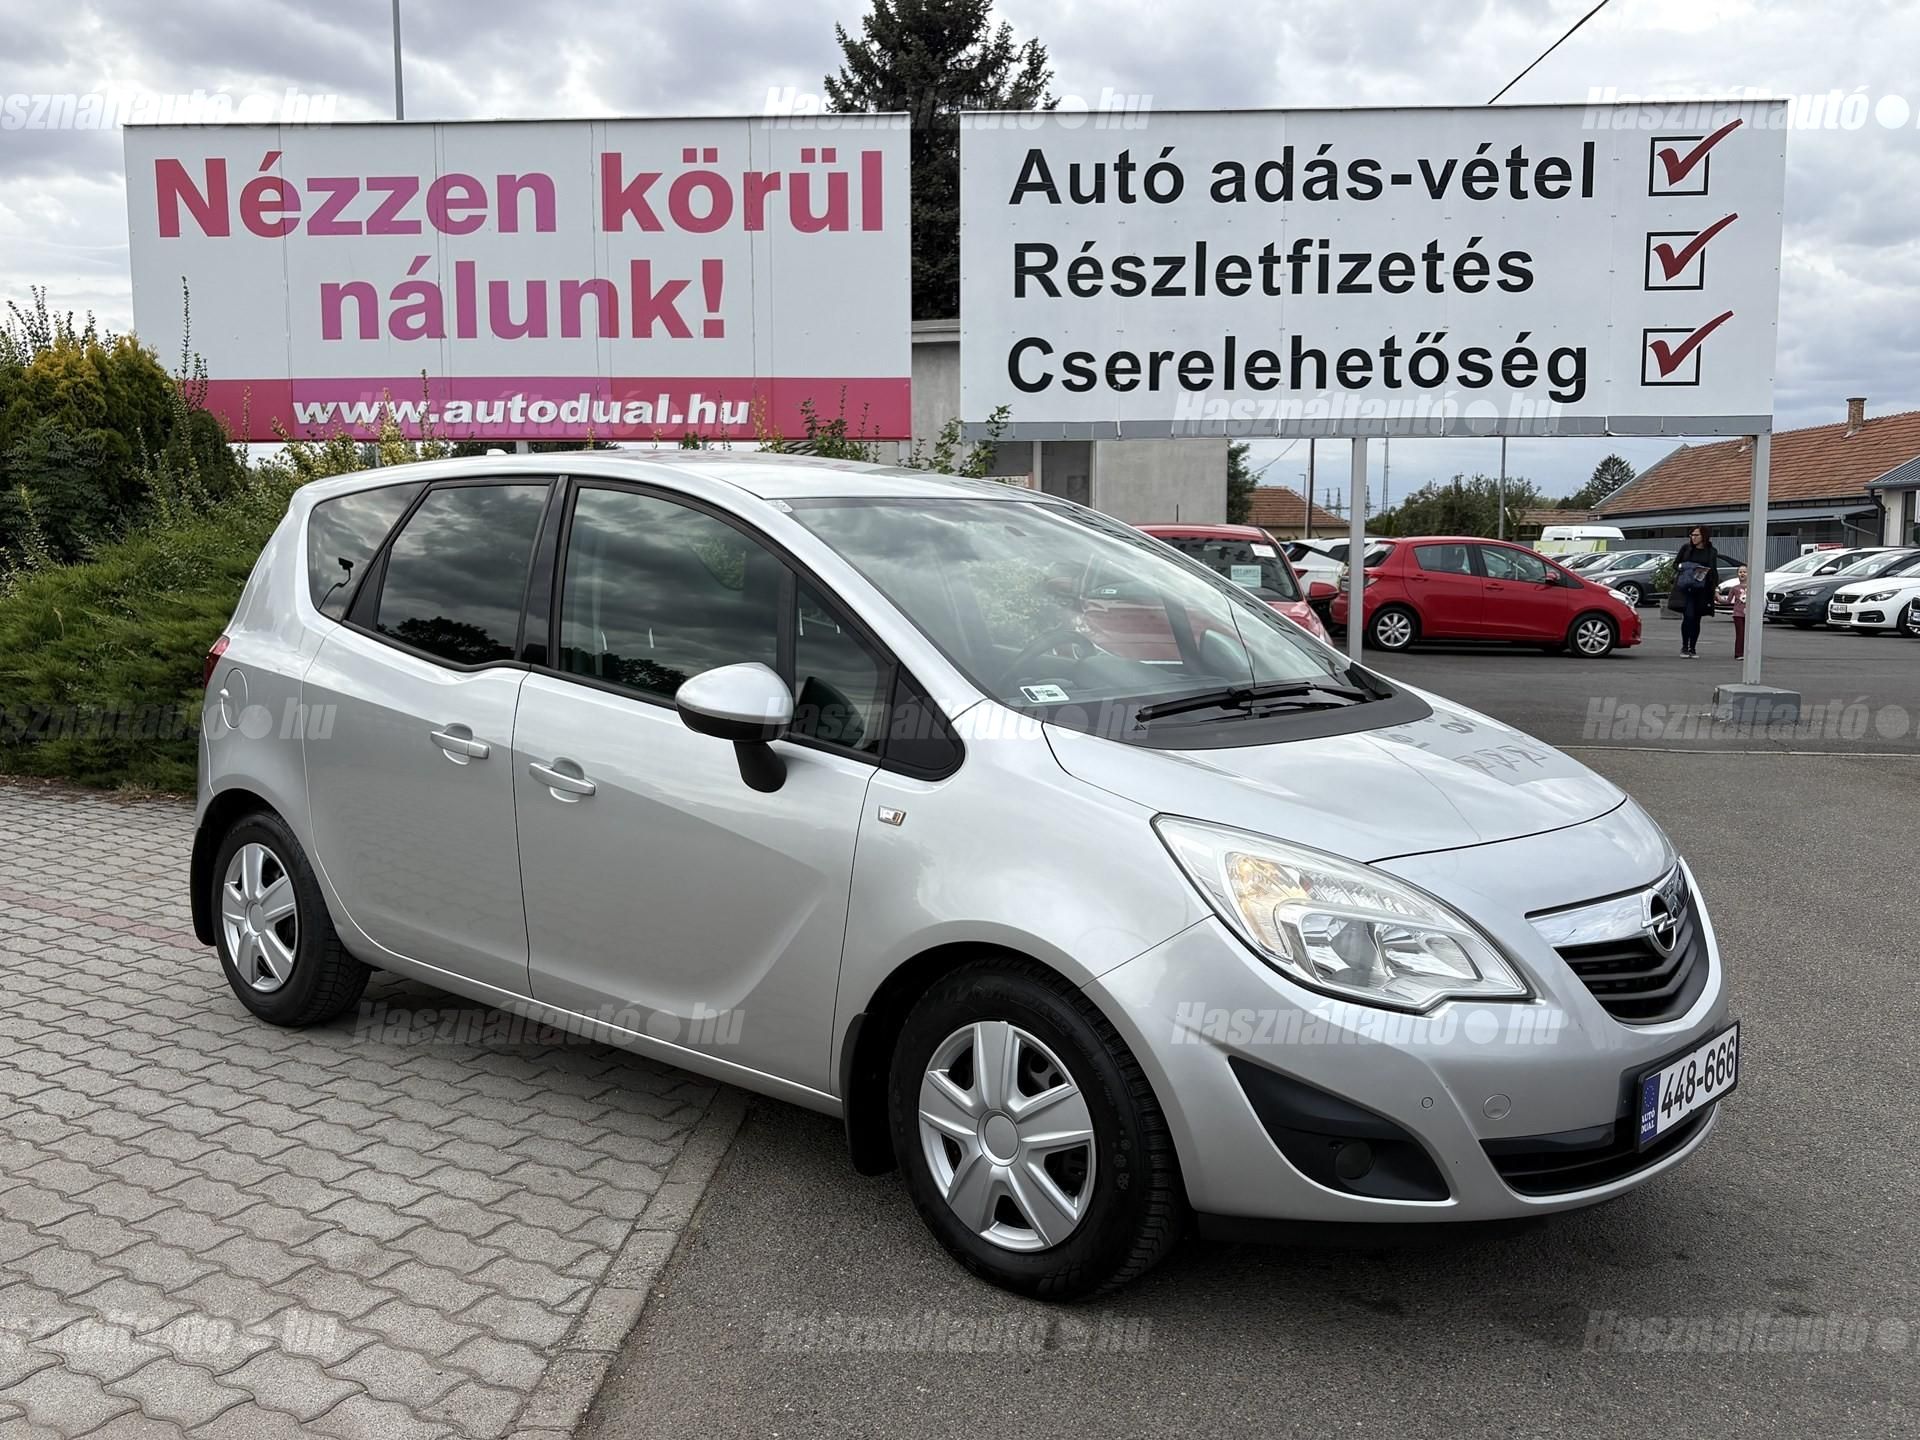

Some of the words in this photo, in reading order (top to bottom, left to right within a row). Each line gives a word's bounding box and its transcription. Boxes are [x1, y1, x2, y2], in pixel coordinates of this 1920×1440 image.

[154, 151, 556, 238] Nézzen
[602, 149, 883, 233] körül
[1009, 146, 1184, 205] Autó
[1210, 142, 1595, 203] adás-vétel
[321, 256, 724, 340] nálunk!
[1014, 236, 1534, 298] Részletfizetés
[1008, 331, 1588, 403] Cserelehetőség
[293, 393, 751, 427] www.autodual.hu
[1661, 1035, 1735, 1119] 448-666
